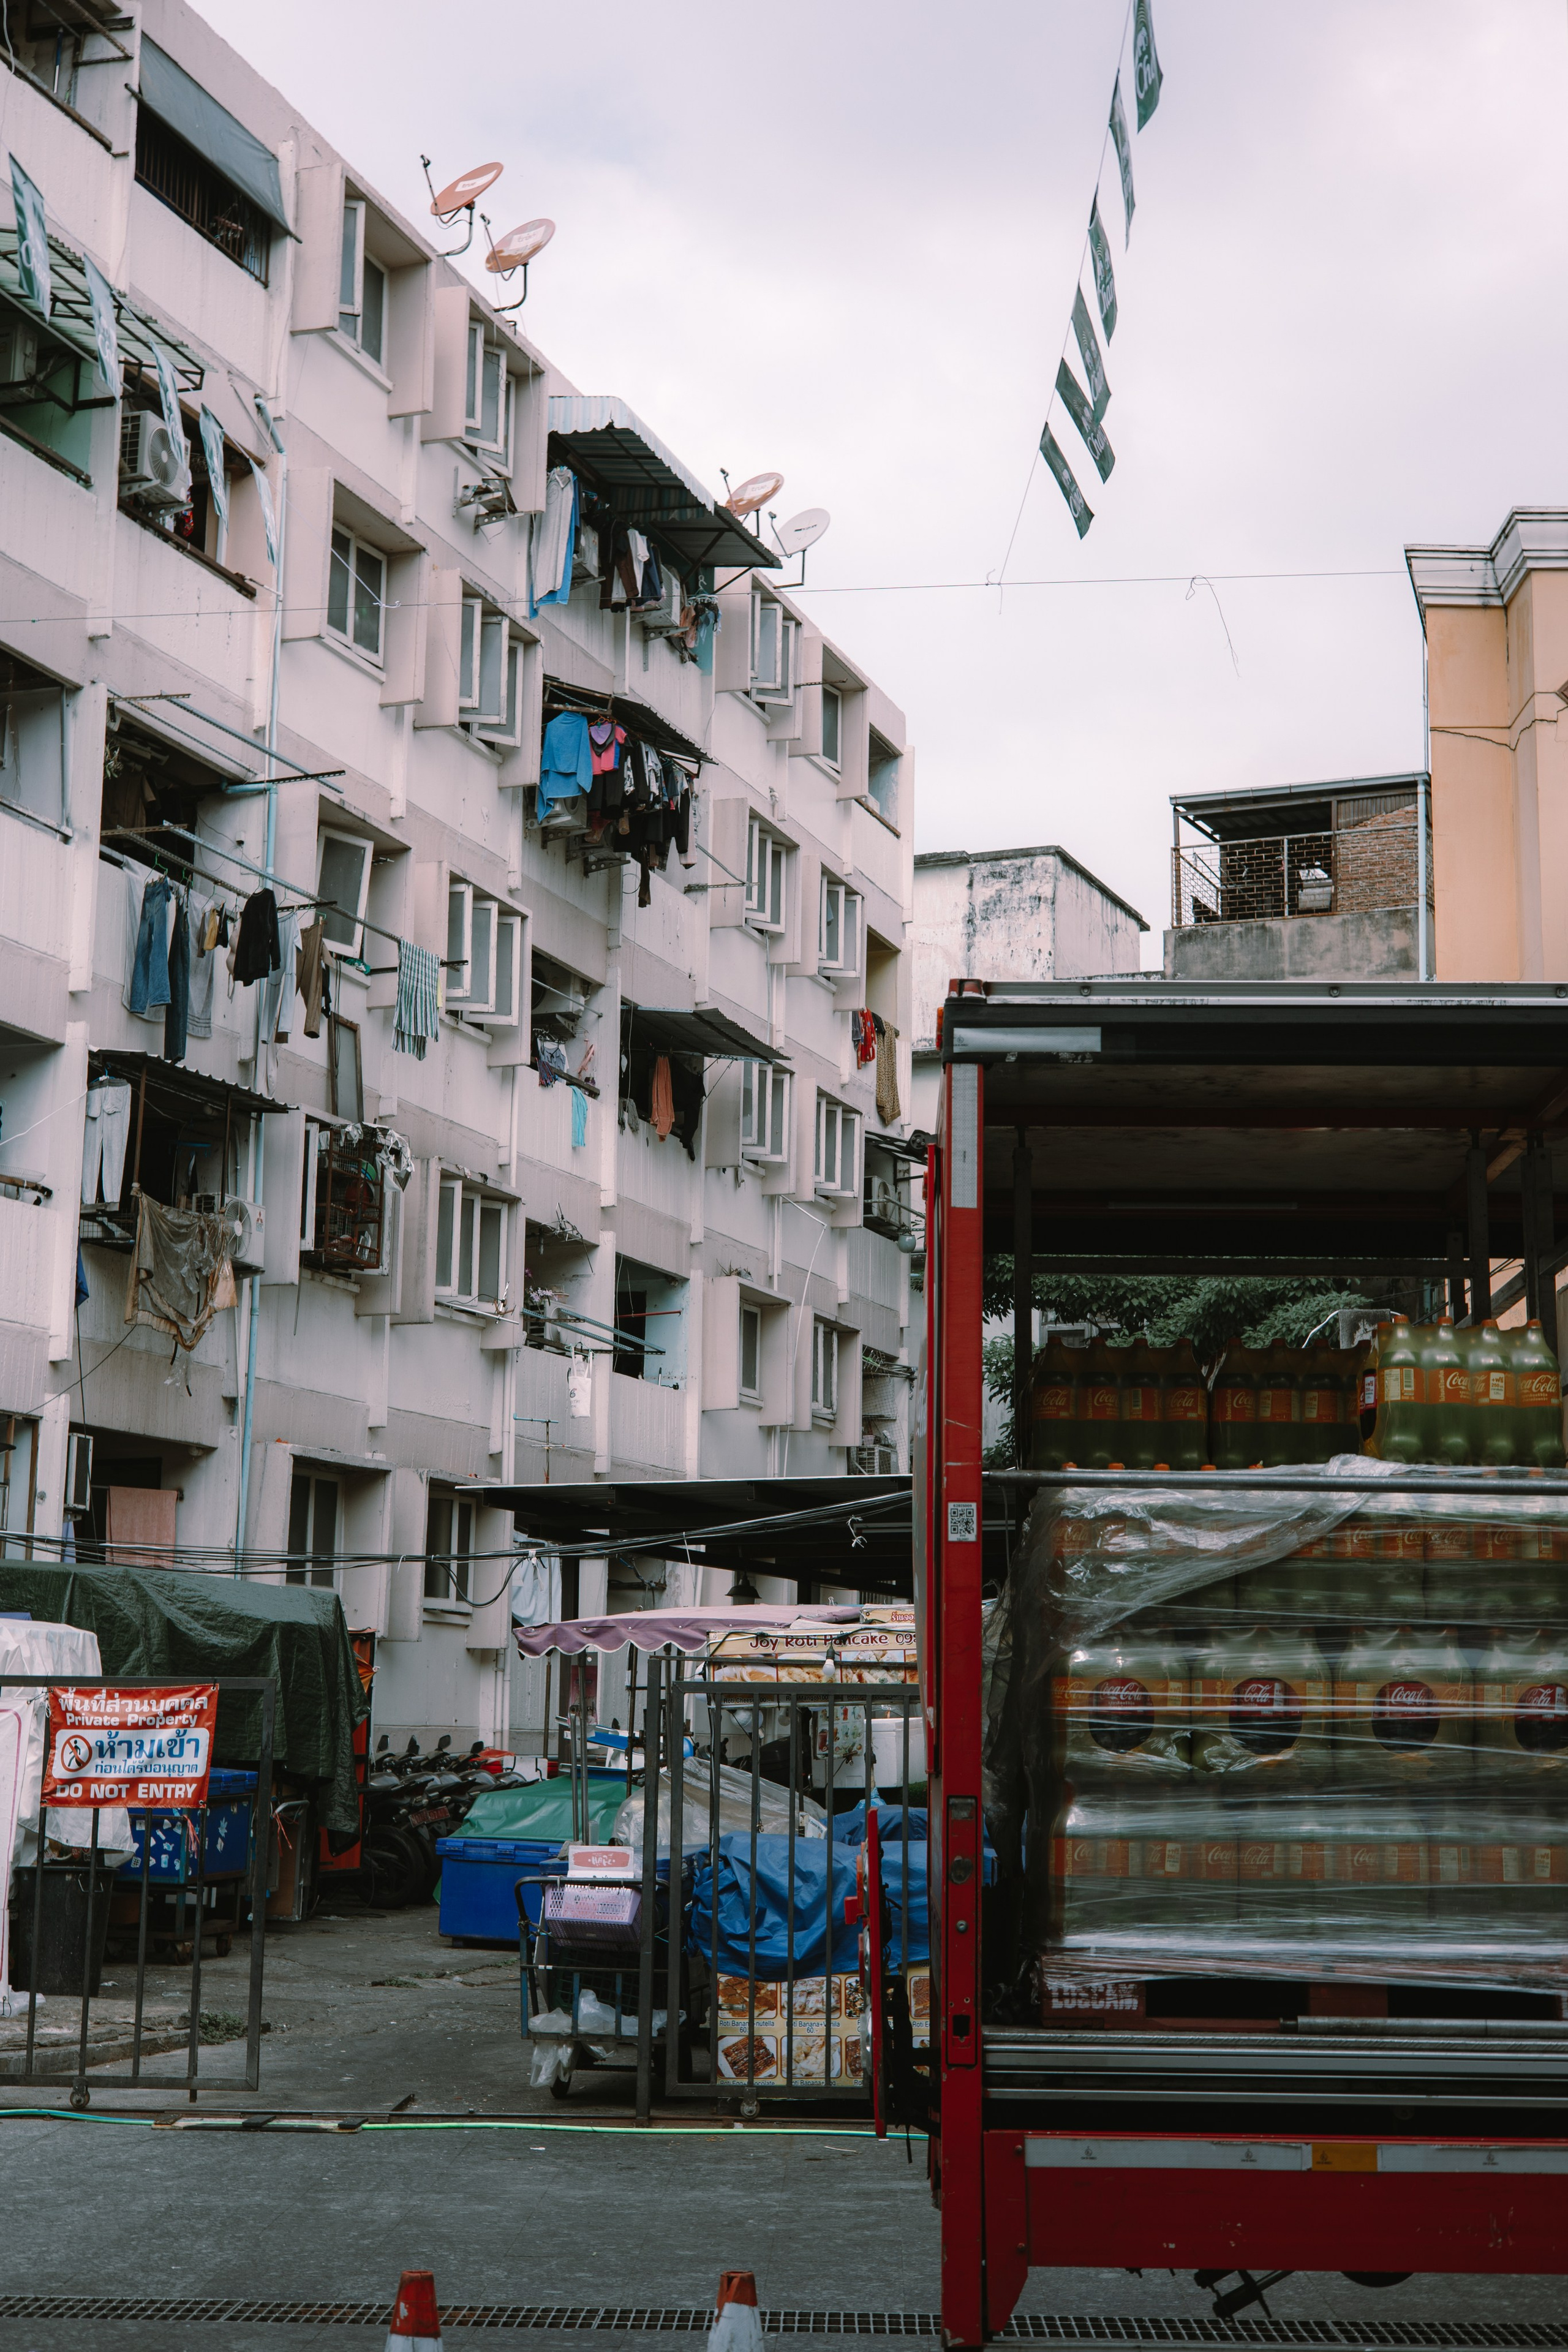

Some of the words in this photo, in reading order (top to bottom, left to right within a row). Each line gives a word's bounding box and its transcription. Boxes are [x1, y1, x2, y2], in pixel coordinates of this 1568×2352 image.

[749, 1635, 780, 1653] Joy
[785, 1634, 818, 1648] Roti
[824, 1634, 889, 1646] Pancake
[1099, 1682, 1142, 1701] Coca-Cola
[59, 1687, 208, 1717] พื้นที่ส่วนบุคคล
[66, 1713, 120, 1726] Private
[127, 1713, 197, 1728] Property
[95, 1728, 200, 1759] ห้ามเข้า
[95, 1760, 198, 1777] ก่อนได้รับอนุญาต
[56, 1783, 83, 1798] DO
[90, 1784, 130, 1799] NOT
[138, 1784, 197, 1799] ENTRY
